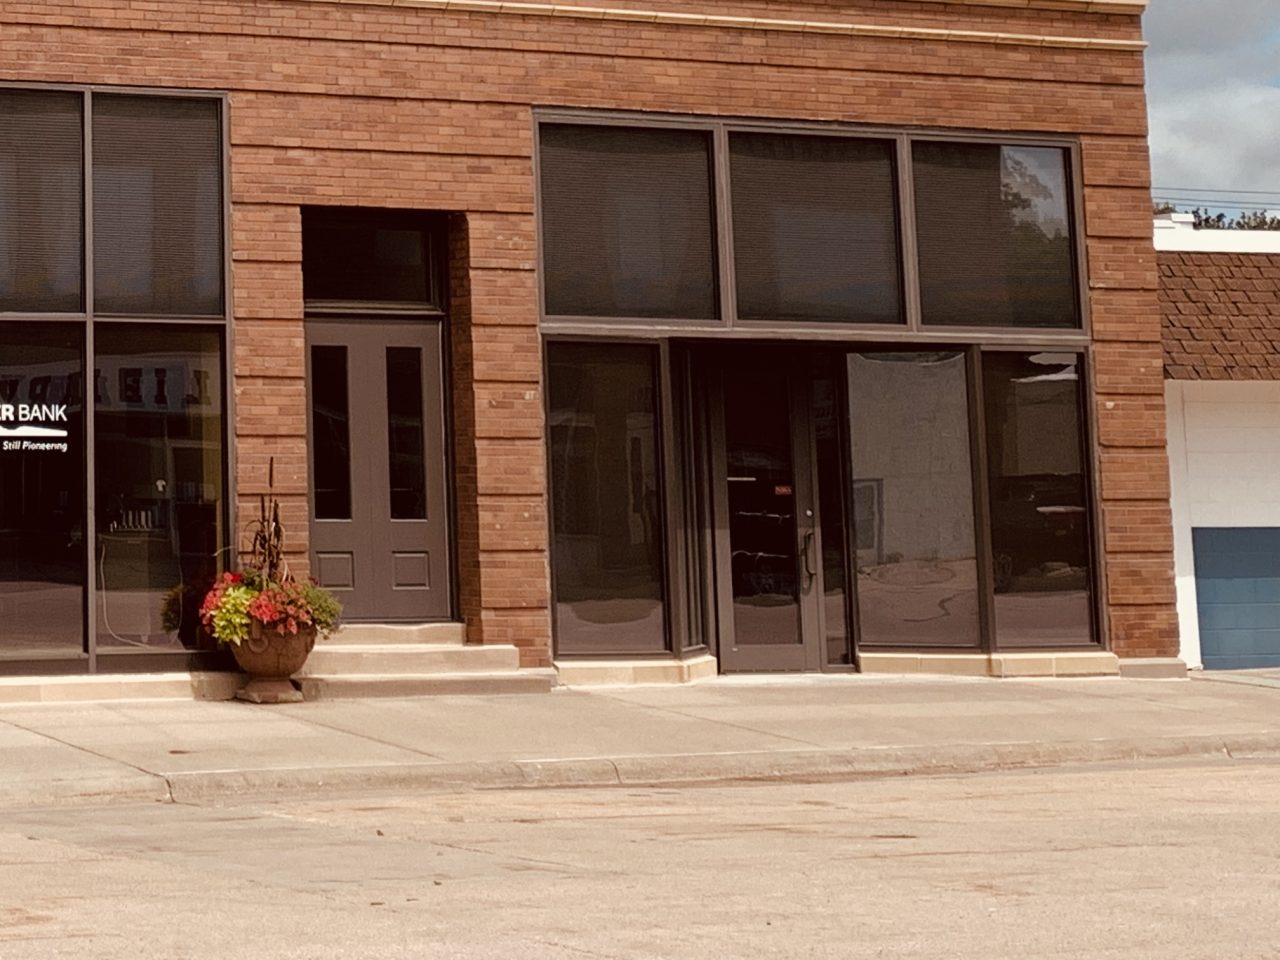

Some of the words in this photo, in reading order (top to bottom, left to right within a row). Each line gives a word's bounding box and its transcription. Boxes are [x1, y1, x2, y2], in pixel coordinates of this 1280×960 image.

[18, 404, 68, 422] BANK
[2, 440, 21, 451] Still
[22, 440, 68, 453] Pioneering
